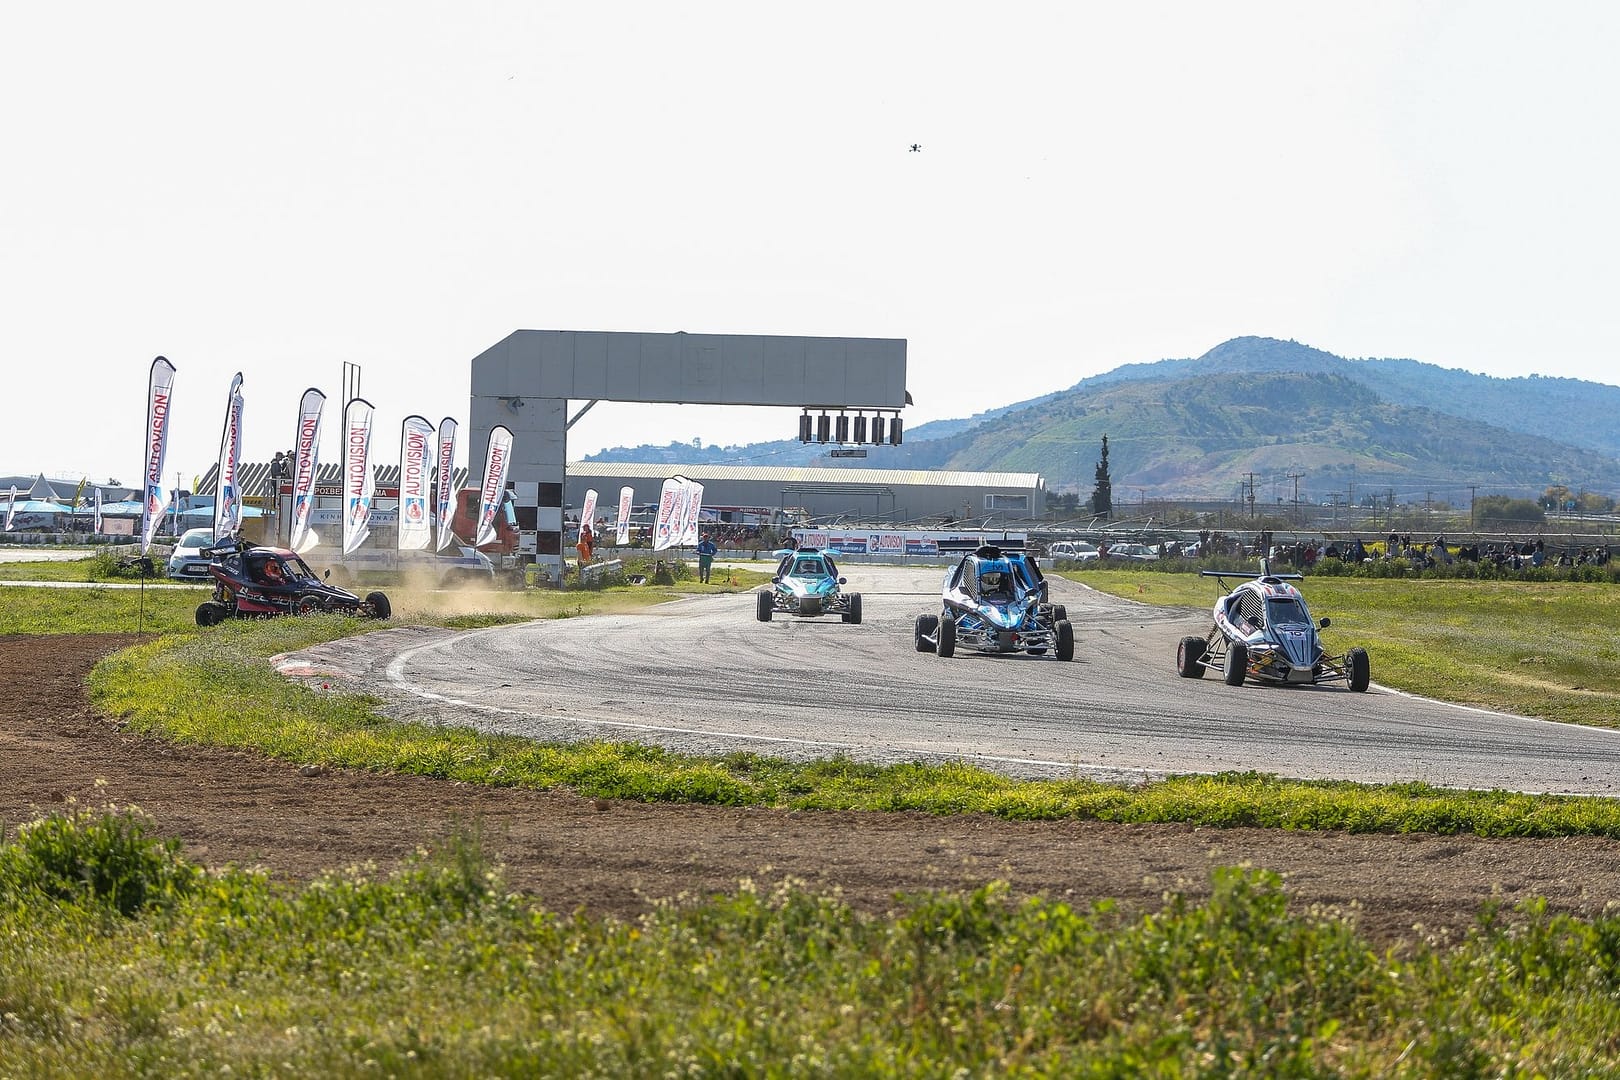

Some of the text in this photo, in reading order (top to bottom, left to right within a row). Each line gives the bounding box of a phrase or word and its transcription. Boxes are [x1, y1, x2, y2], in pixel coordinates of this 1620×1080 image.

[149, 393, 168, 482] AUTOVISION
[297, 418, 316, 493] AUTOVISION
[349, 428, 365, 496] AUTOVISION
[405, 432, 425, 496] AUTOVISION
[440, 442, 452, 501] AUTOVISION
[485, 448, 503, 503] AUTOVISION
